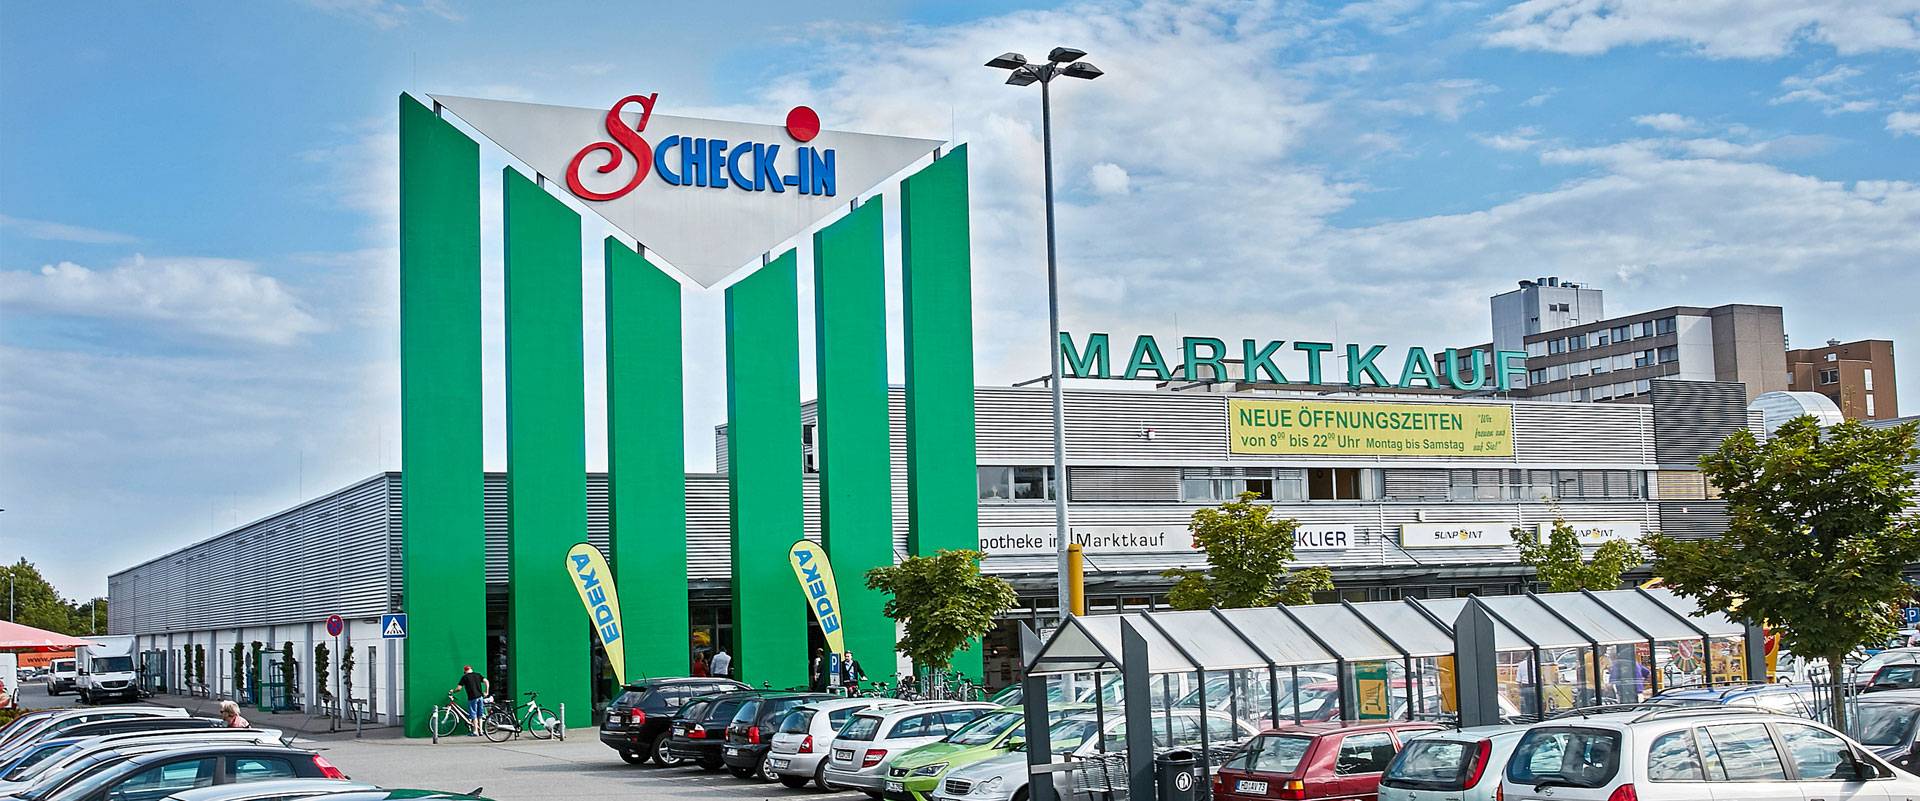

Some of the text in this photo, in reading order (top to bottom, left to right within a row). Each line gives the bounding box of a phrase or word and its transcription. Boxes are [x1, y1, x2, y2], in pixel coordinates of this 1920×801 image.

[1060, 332, 1528, 391] MARKTKAUF
[1240, 406, 1463, 430] NEUE ÖFFNUNGSZEITEN
[1241, 436, 1266, 447] von
[1290, 434, 1309, 447] bis
[1338, 435, 1360, 448] Uhr
[1366, 438, 1402, 450] Montag
[1405, 439, 1420, 449] bis
[1423, 439, 1464, 451] Samstag
[980, 534, 1042, 551] potheke
[1077, 532, 1165, 548] Marktkauf
[1298, 531, 1346, 547] KLIER
[1909, 610, 1916, 621] P
[831, 657, 838, 671] P
